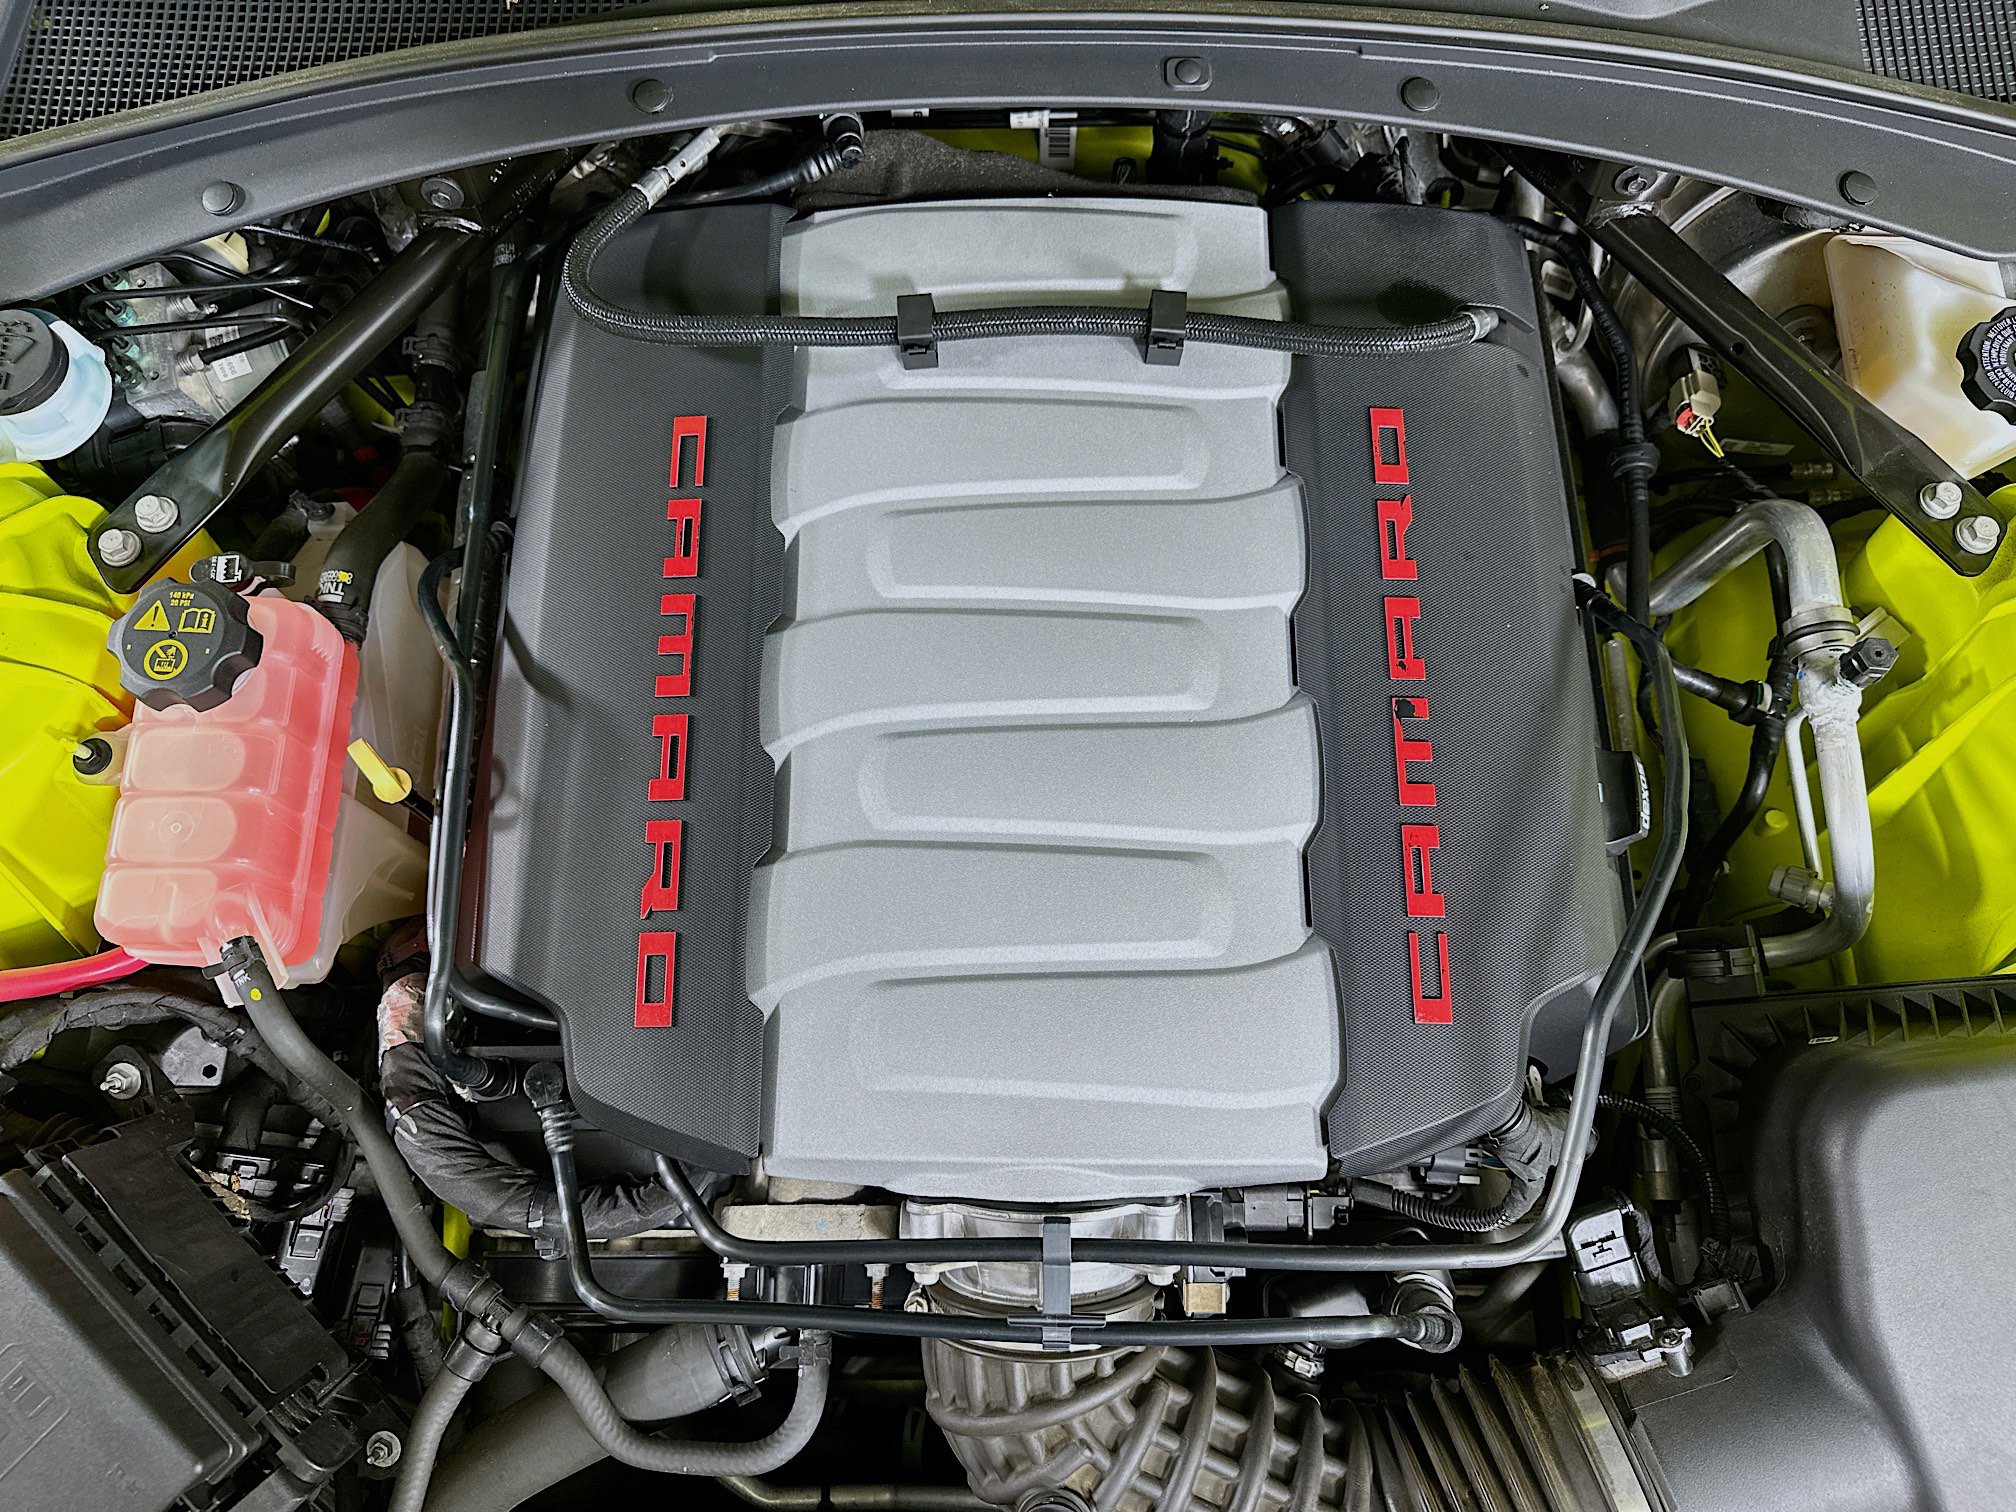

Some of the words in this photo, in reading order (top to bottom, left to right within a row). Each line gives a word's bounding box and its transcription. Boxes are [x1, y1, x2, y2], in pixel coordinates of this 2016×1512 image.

[1995, 368, 2006, 379] CAP
[1998, 383, 2015, 399] FLUID
[169, 591, 182, 599] 140
[318, 582, 345, 596] TNK
[179, 599, 191, 607] PSI
[634, 415, 706, 1027] CAMARO
[1369, 407, 1453, 1024] CAMARO
[1636, 761, 1651, 830] dexos
[234, 973, 252, 988] TNK
